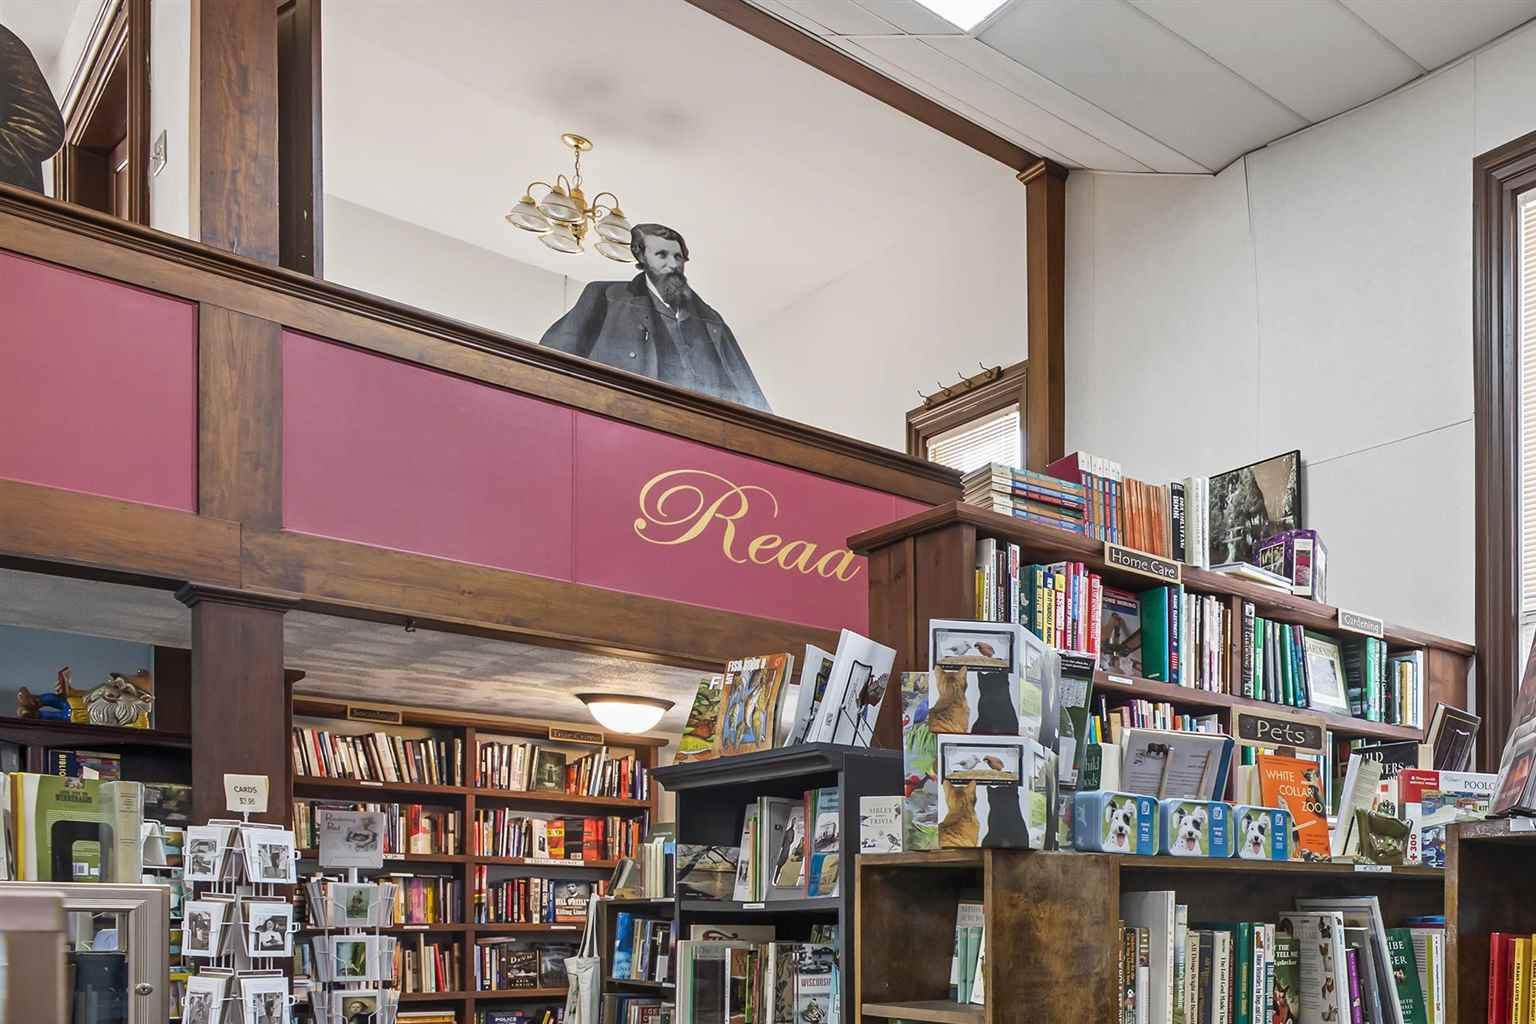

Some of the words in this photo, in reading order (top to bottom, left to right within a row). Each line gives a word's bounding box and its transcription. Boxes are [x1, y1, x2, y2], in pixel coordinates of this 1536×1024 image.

[1110, 548, 1149, 571] Home
[1149, 560, 1176, 578] Care
[1343, 614, 1381, 632] Gardening
[1255, 719, 1306, 744] Pets
[1263, 769, 1296, 783] WHITE
[233, 784, 258, 794] CARDS
[1279, 784, 1314, 797] COLLAR
[1301, 800, 1324, 814] ZOO
